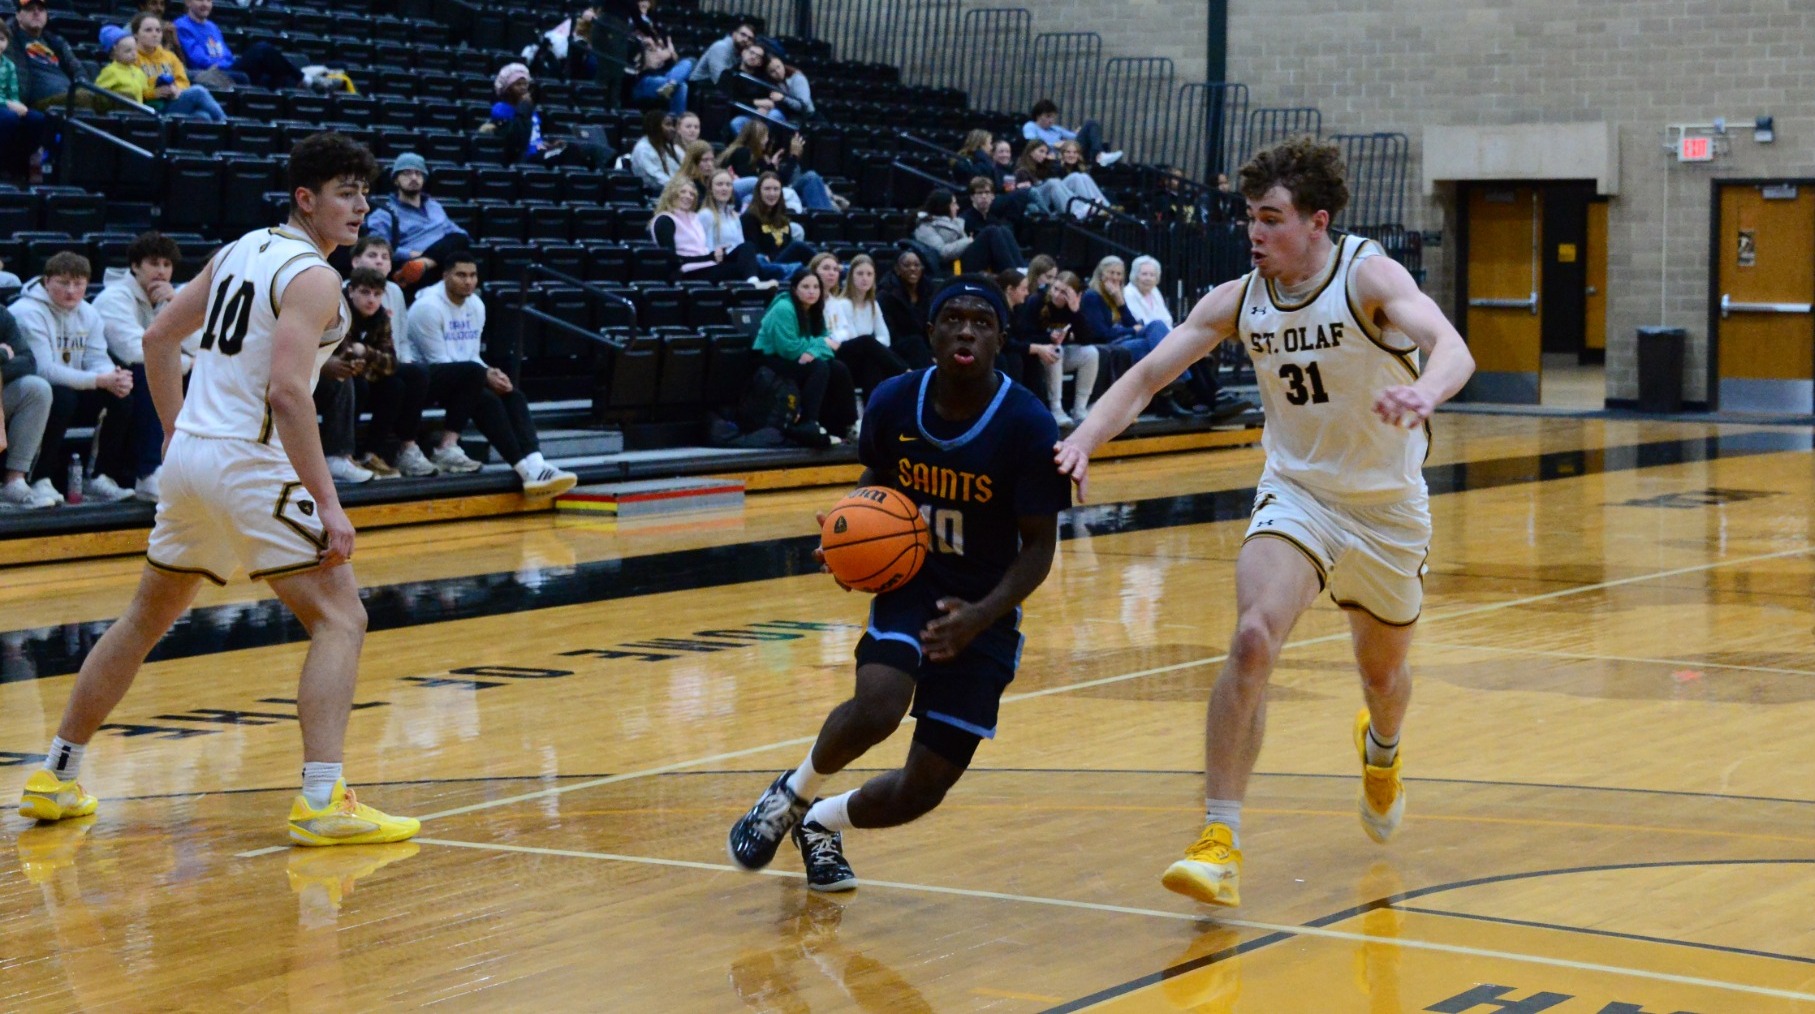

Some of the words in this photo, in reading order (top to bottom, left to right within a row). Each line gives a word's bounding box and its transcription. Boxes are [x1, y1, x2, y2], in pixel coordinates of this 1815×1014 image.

[200, 273, 256, 357] 10
[1250, 332, 1280, 354] ST.
[1283, 322, 1345, 352] OLAF
[1278, 361, 1330, 406] 31
[898, 457, 993, 504] SAINTS
[557, 619, 862, 662] HOME
[398, 665, 576, 691] OF
